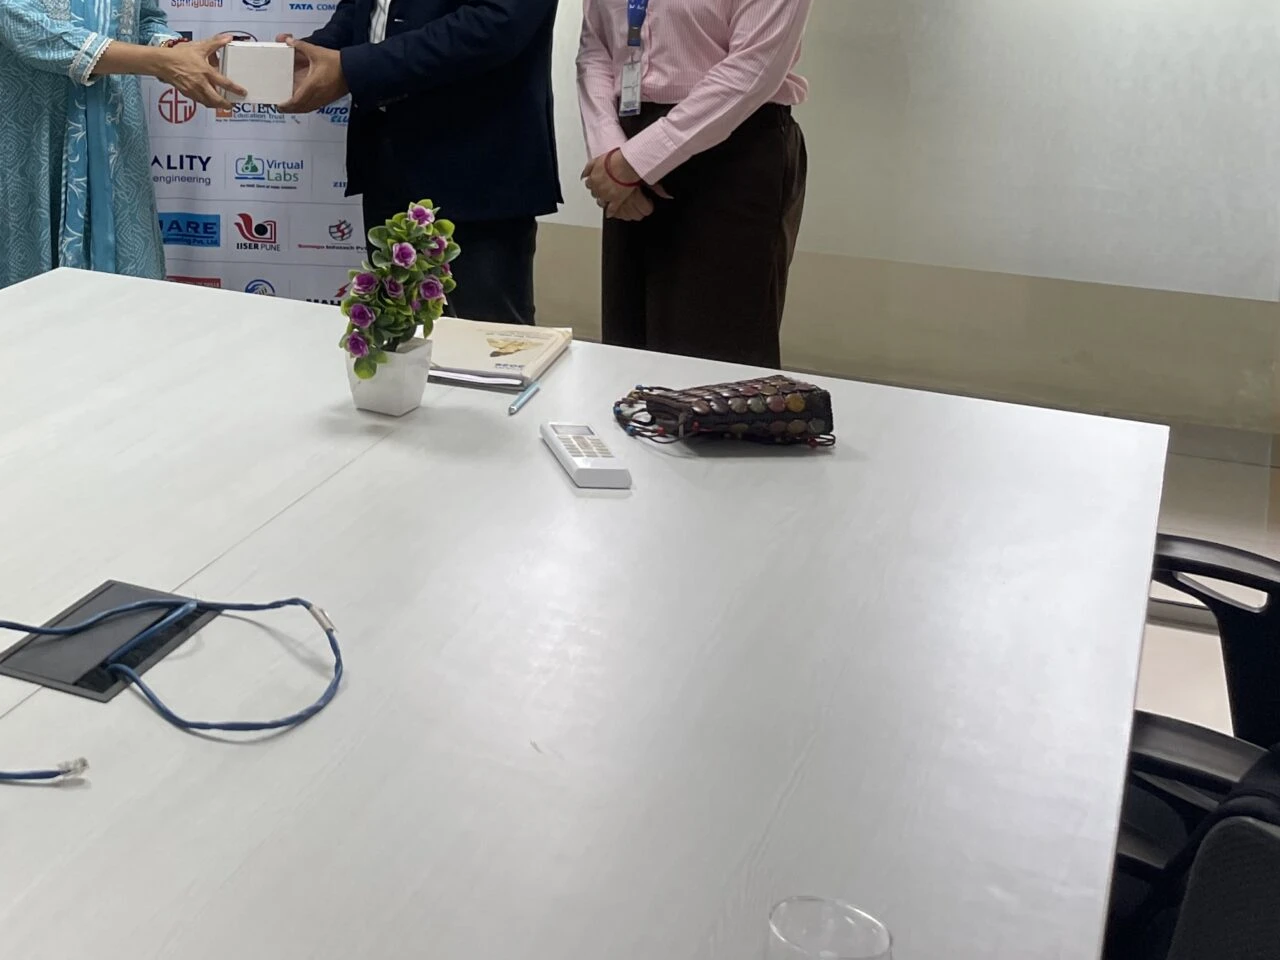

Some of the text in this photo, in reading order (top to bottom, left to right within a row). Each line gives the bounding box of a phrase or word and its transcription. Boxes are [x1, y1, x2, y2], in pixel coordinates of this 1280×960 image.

[266, 159, 304, 170] Virtual
[152, 175, 211, 186] engineering
[266, 169, 299, 182] Labs
[237, 242, 281, 251] IISER PUNE
